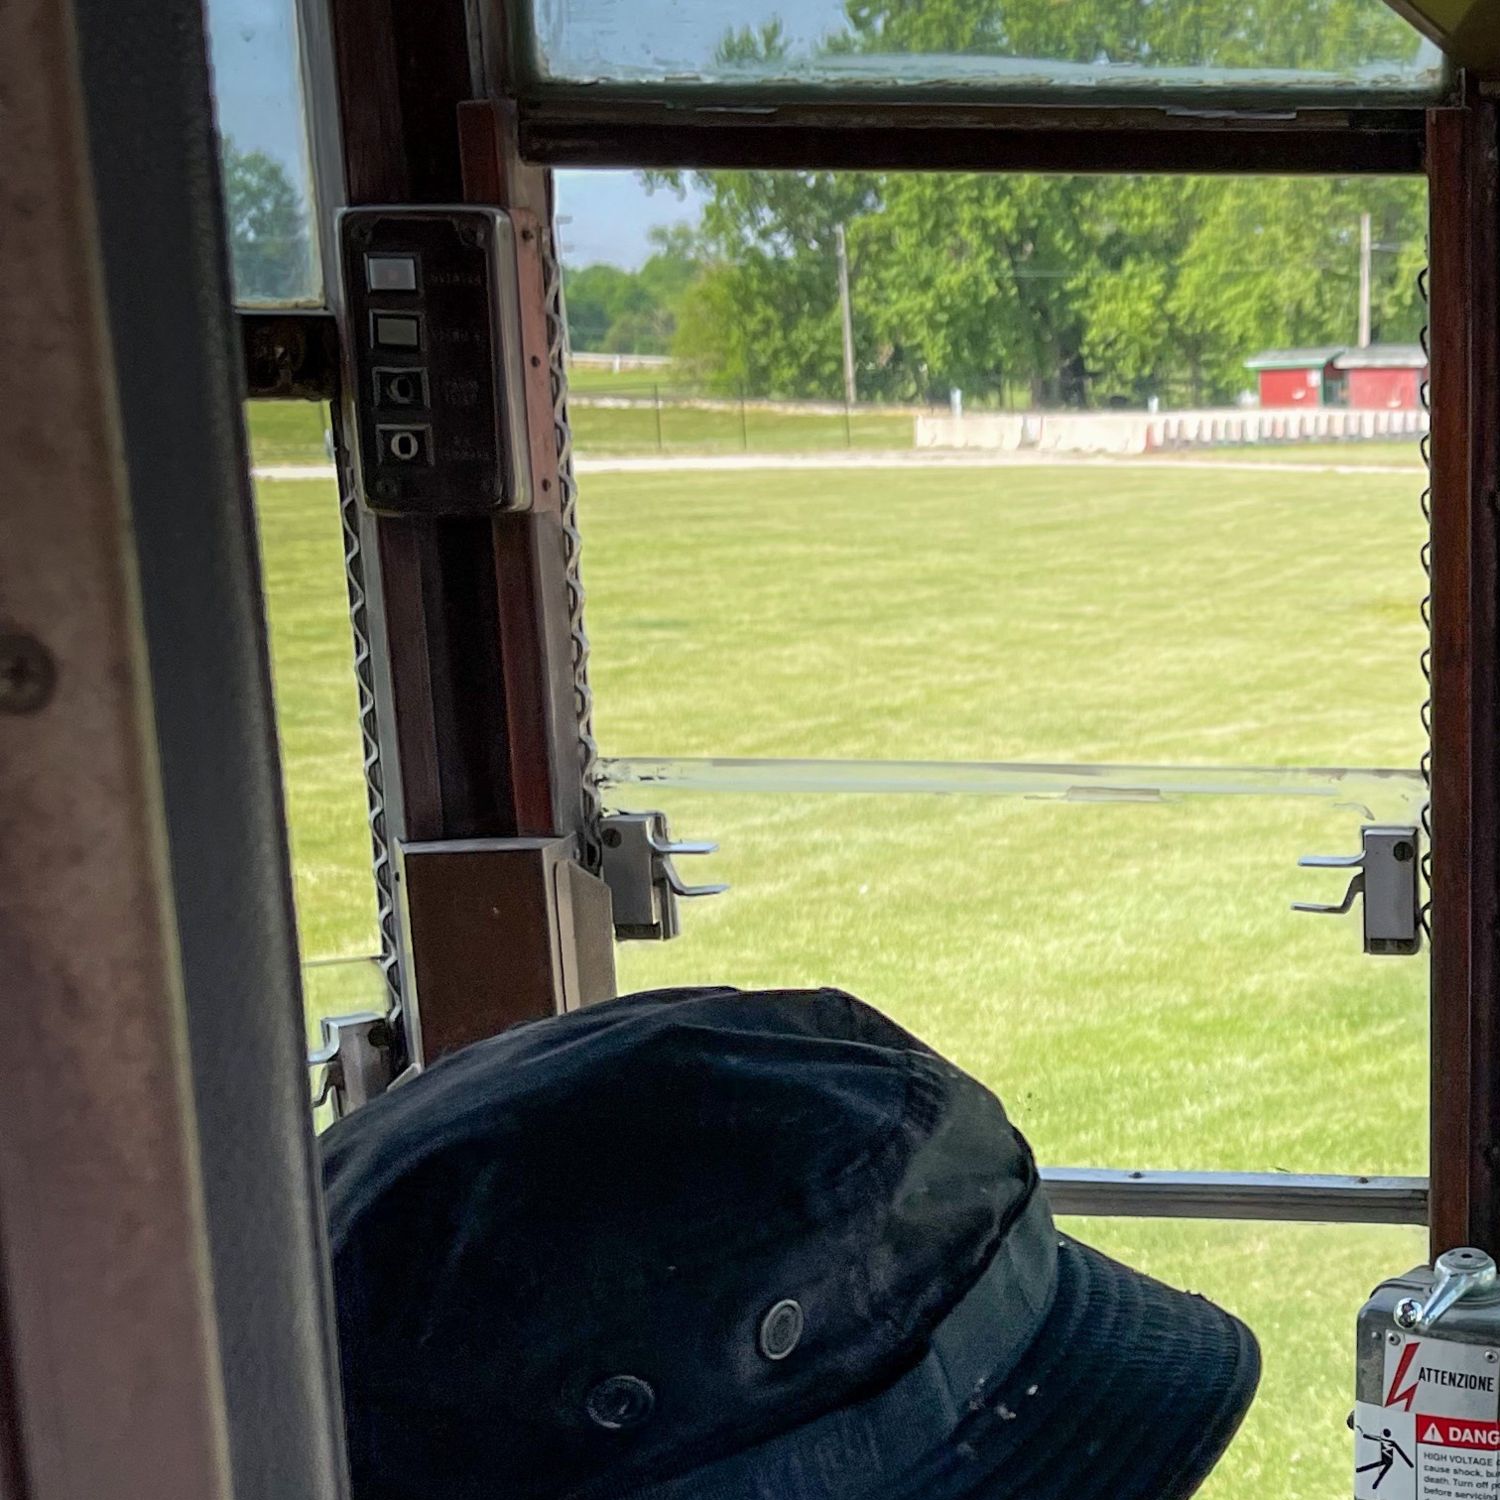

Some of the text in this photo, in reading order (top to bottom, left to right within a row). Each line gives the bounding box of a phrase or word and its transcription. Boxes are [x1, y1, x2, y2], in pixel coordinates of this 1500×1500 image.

[1418, 1366, 1495, 1392] ATTENZIONE
[1423, 1452, 1447, 1462] HIGH
[1449, 1455, 1493, 1467] VOLTAGE
[1423, 1465, 1450, 1473] cause
[1452, 1478, 1474, 1488] Turn
[1476, 1481, 1489, 1489] off
[1423, 1487, 1452, 1497] before
